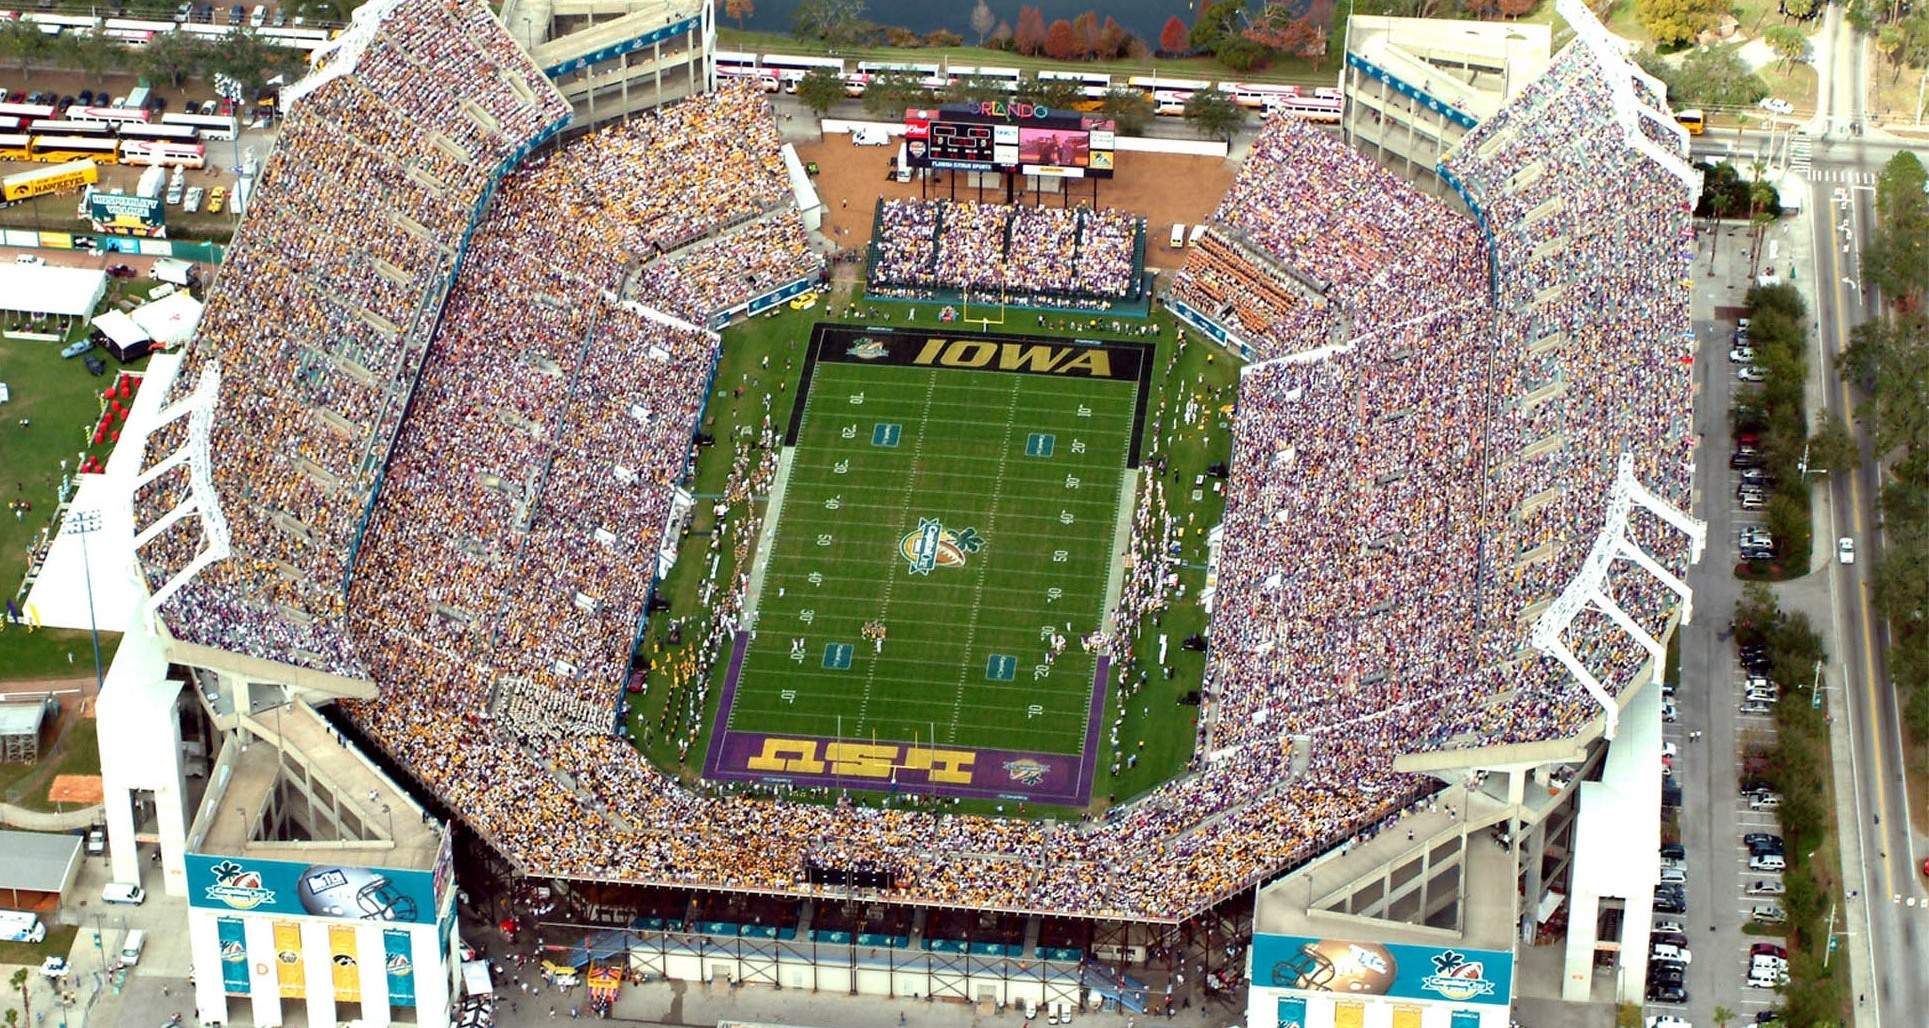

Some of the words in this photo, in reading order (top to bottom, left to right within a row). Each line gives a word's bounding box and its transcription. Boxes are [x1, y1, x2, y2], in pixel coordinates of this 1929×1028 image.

[970, 100, 1049, 121] ORLANDO
[34, 176, 85, 192] HAWKEYES
[913, 338, 1112, 376] IOWA
[850, 394, 863, 404] 10
[1077, 407, 1092, 417] 10
[842, 427, 855, 439] 20
[1072, 441, 1085, 453] 20
[834, 462, 847, 473] 30
[1065, 476, 1080, 489] 30
[825, 498, 839, 509] 40
[1060, 512, 1074, 525] 40
[817, 534, 831, 545] 50
[1053, 551, 1068, 561] 50
[808, 571, 822, 582] 40
[1048, 588, 1061, 598] 40
[800, 609, 815, 621] 30
[1035, 664, 1050, 677] 20
[781, 688, 796, 700] 10
[1028, 704, 1043, 715] 10
[256, 963, 269, 975] D
